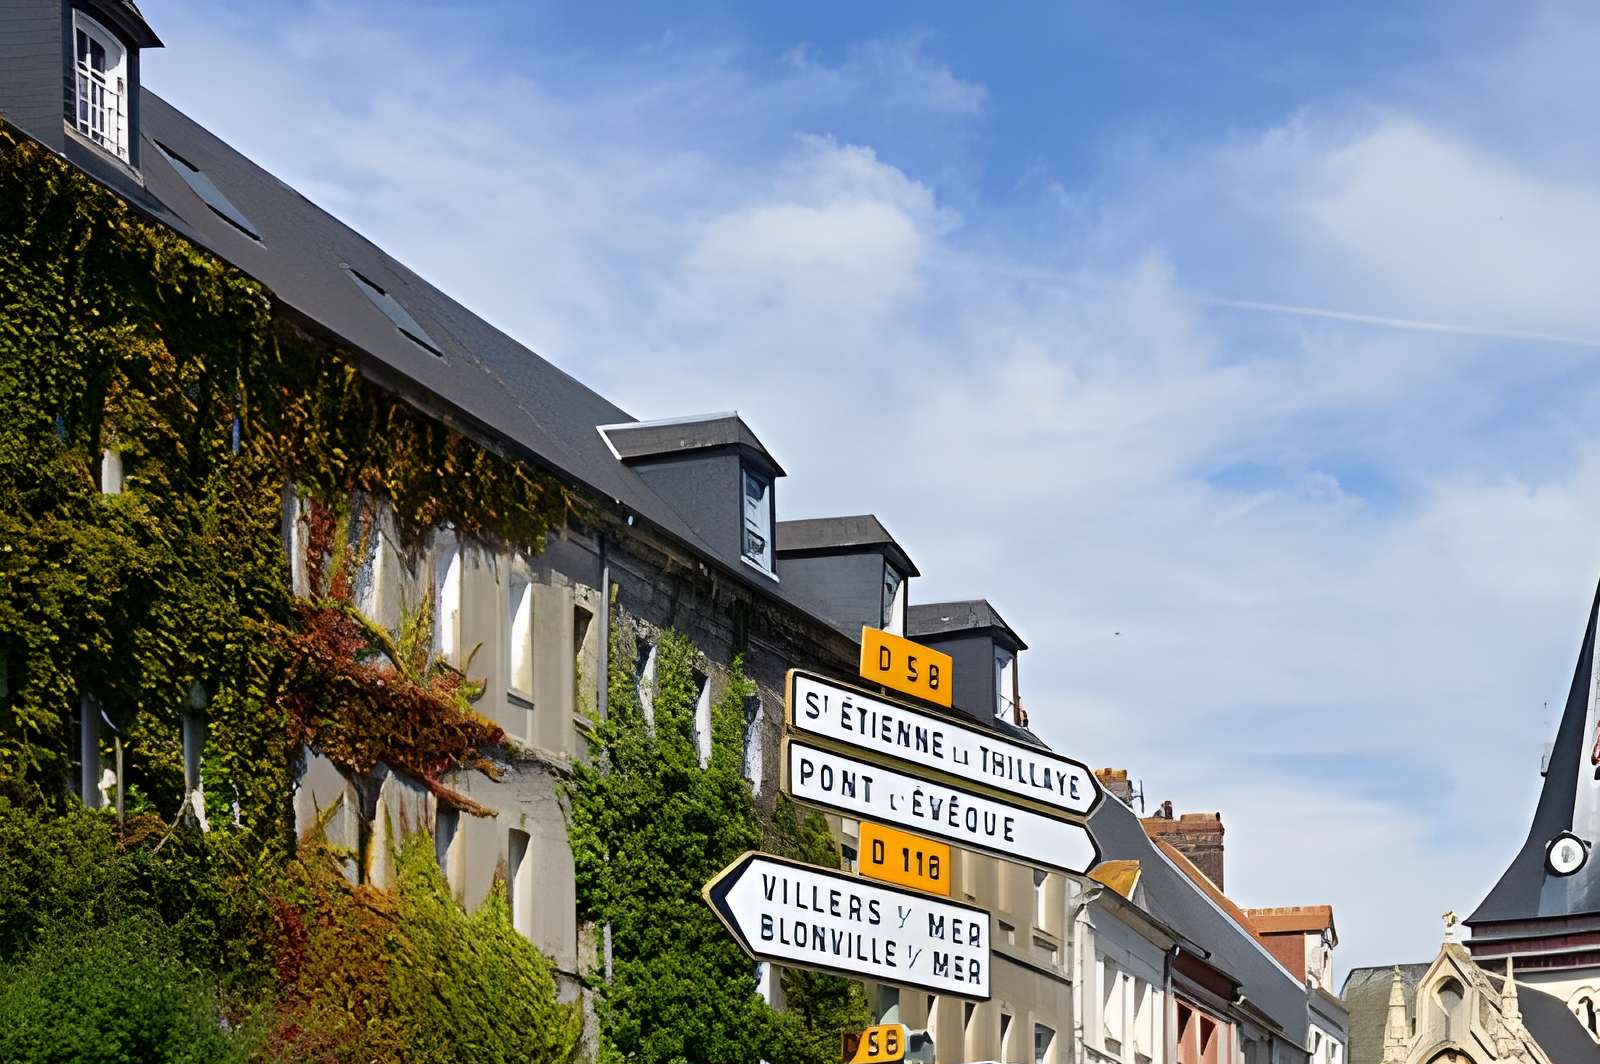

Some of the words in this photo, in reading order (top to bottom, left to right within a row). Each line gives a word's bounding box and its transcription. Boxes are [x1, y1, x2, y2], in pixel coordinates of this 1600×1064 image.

[879, 645, 891, 671] D
[800, 757, 874, 803] PONT
[872, 838, 885, 865] D
[902, 848, 940, 880] 118
[762, 873, 881, 925] VILLERS
[928, 912, 981, 948] MER
[761, 913, 897, 967] BLONVILLE
[933, 951, 981, 985] MER
